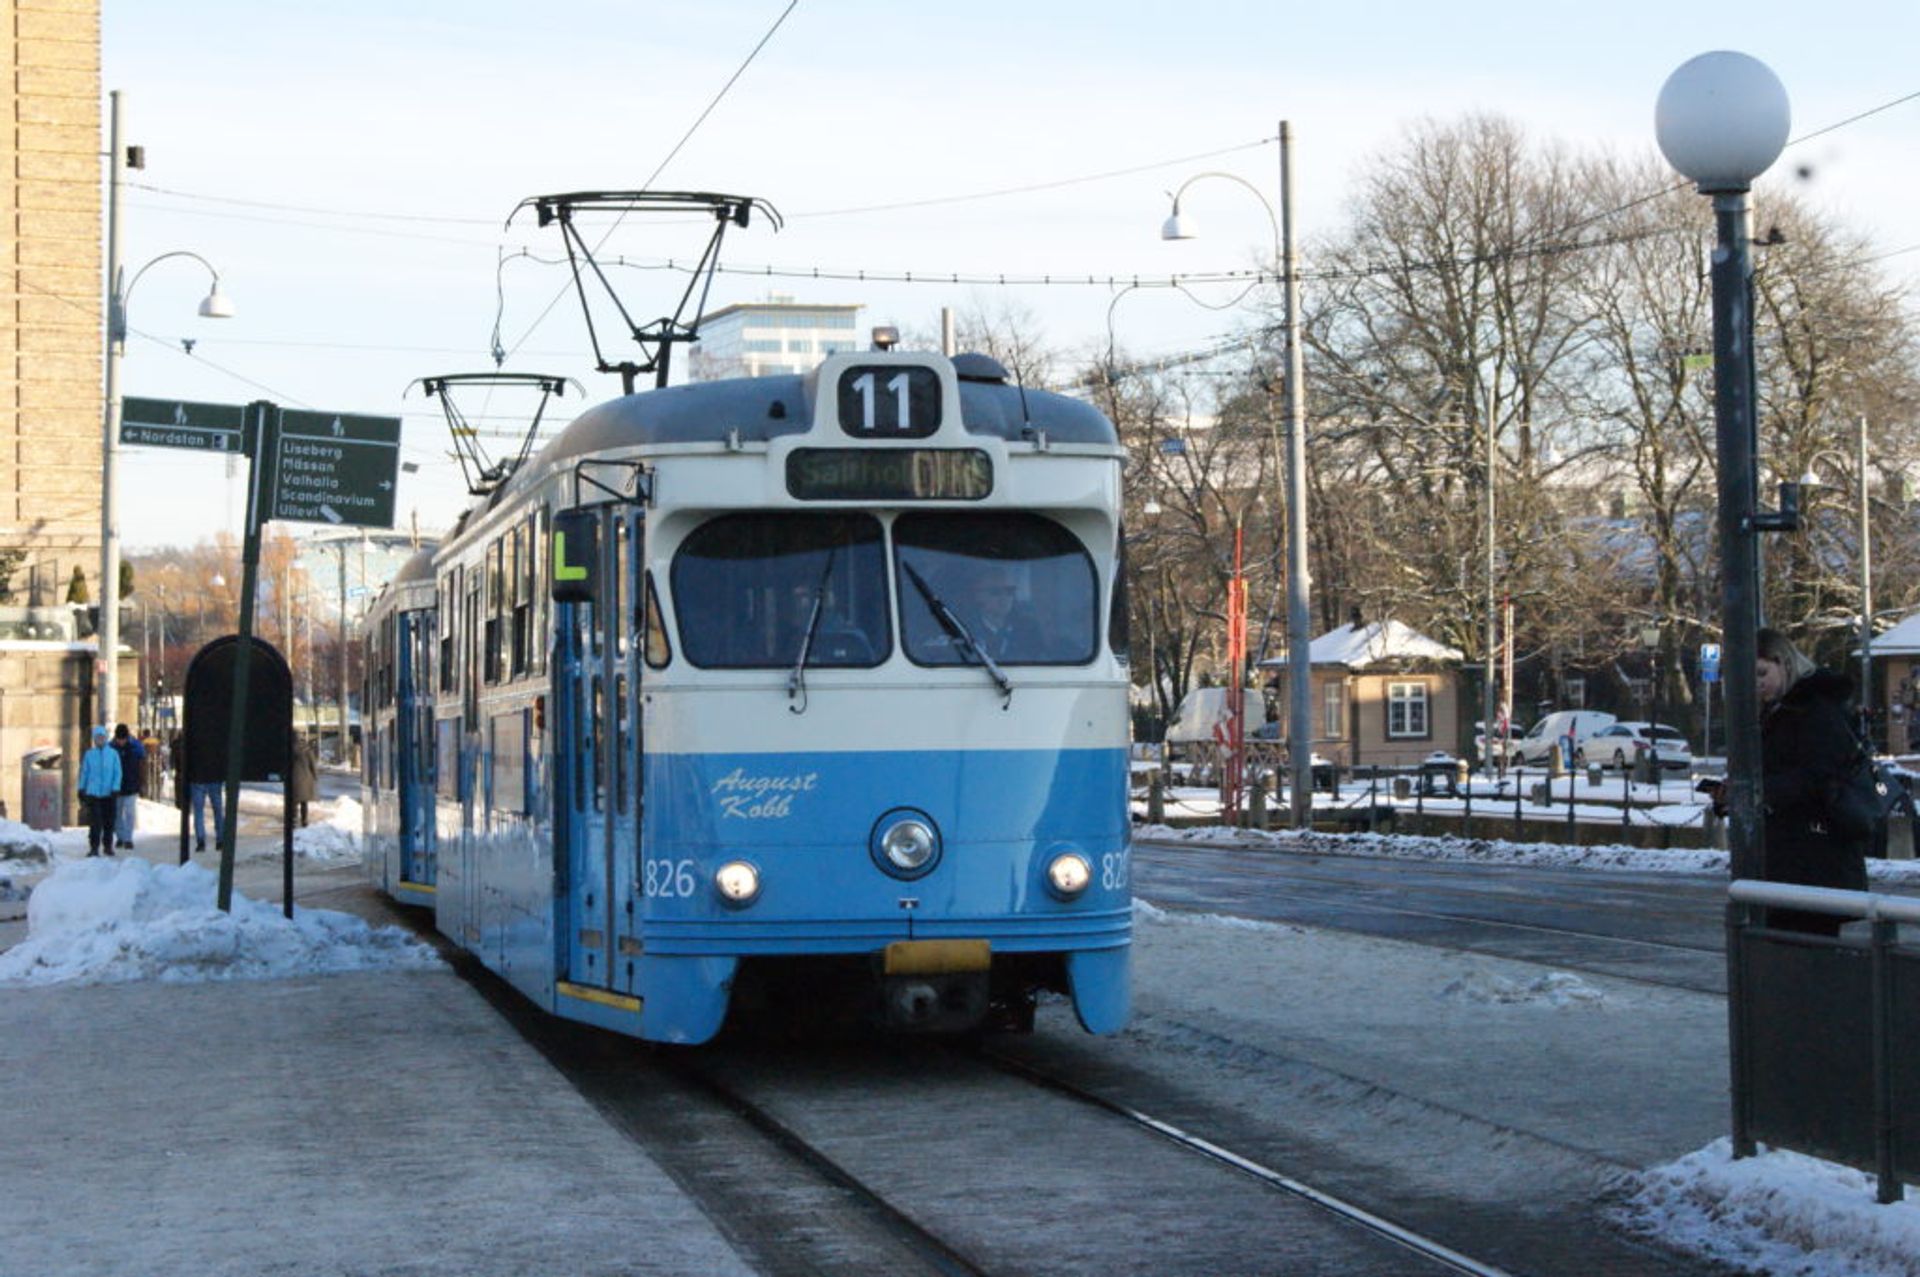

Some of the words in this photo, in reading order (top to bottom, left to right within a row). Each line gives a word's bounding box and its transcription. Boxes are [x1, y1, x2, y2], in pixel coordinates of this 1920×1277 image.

[851, 371, 911, 429] 11
[140, 429, 205, 447] Nordstan
[282, 441, 343, 460] Liseberg
[282, 456, 335, 473] Mässan
[282, 472, 339, 489] Valhalla
[281, 488, 376, 507] Scandinavium
[278, 504, 319, 518] Ullevi
[711, 767, 818, 796] August
[720, 795, 794, 820] Kobb
[645, 858, 696, 899] 826
